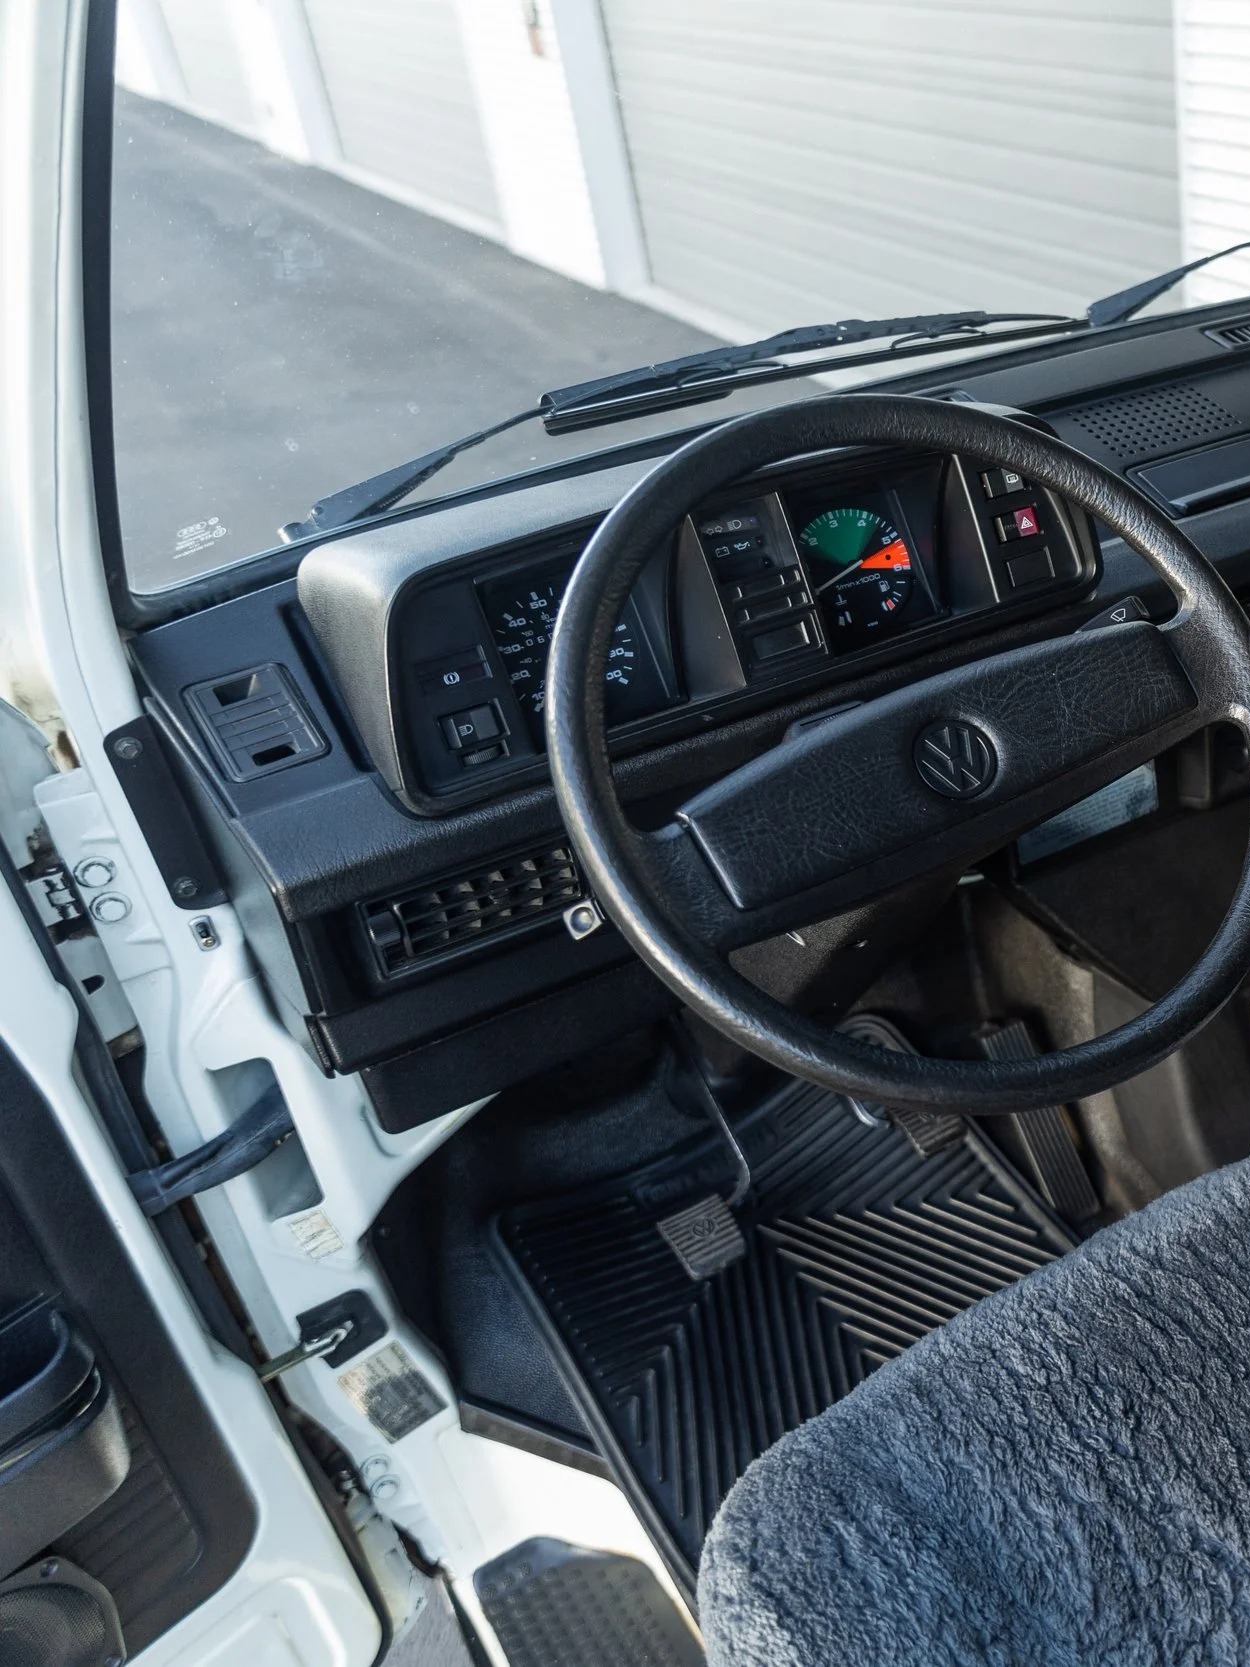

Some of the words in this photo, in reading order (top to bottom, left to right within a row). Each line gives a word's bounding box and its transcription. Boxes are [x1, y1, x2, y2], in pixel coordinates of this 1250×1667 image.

[829, 520, 838, 528] 3
[808, 538, 818, 546] 2
[881, 537, 891, 545] 5
[893, 564, 902, 572] 6
[529, 600, 547, 609] 50
[508, 618, 526, 628] 40
[504, 644, 521, 654] 30
[511, 670, 530, 680] 20
[914, 720, 997, 800] VW
